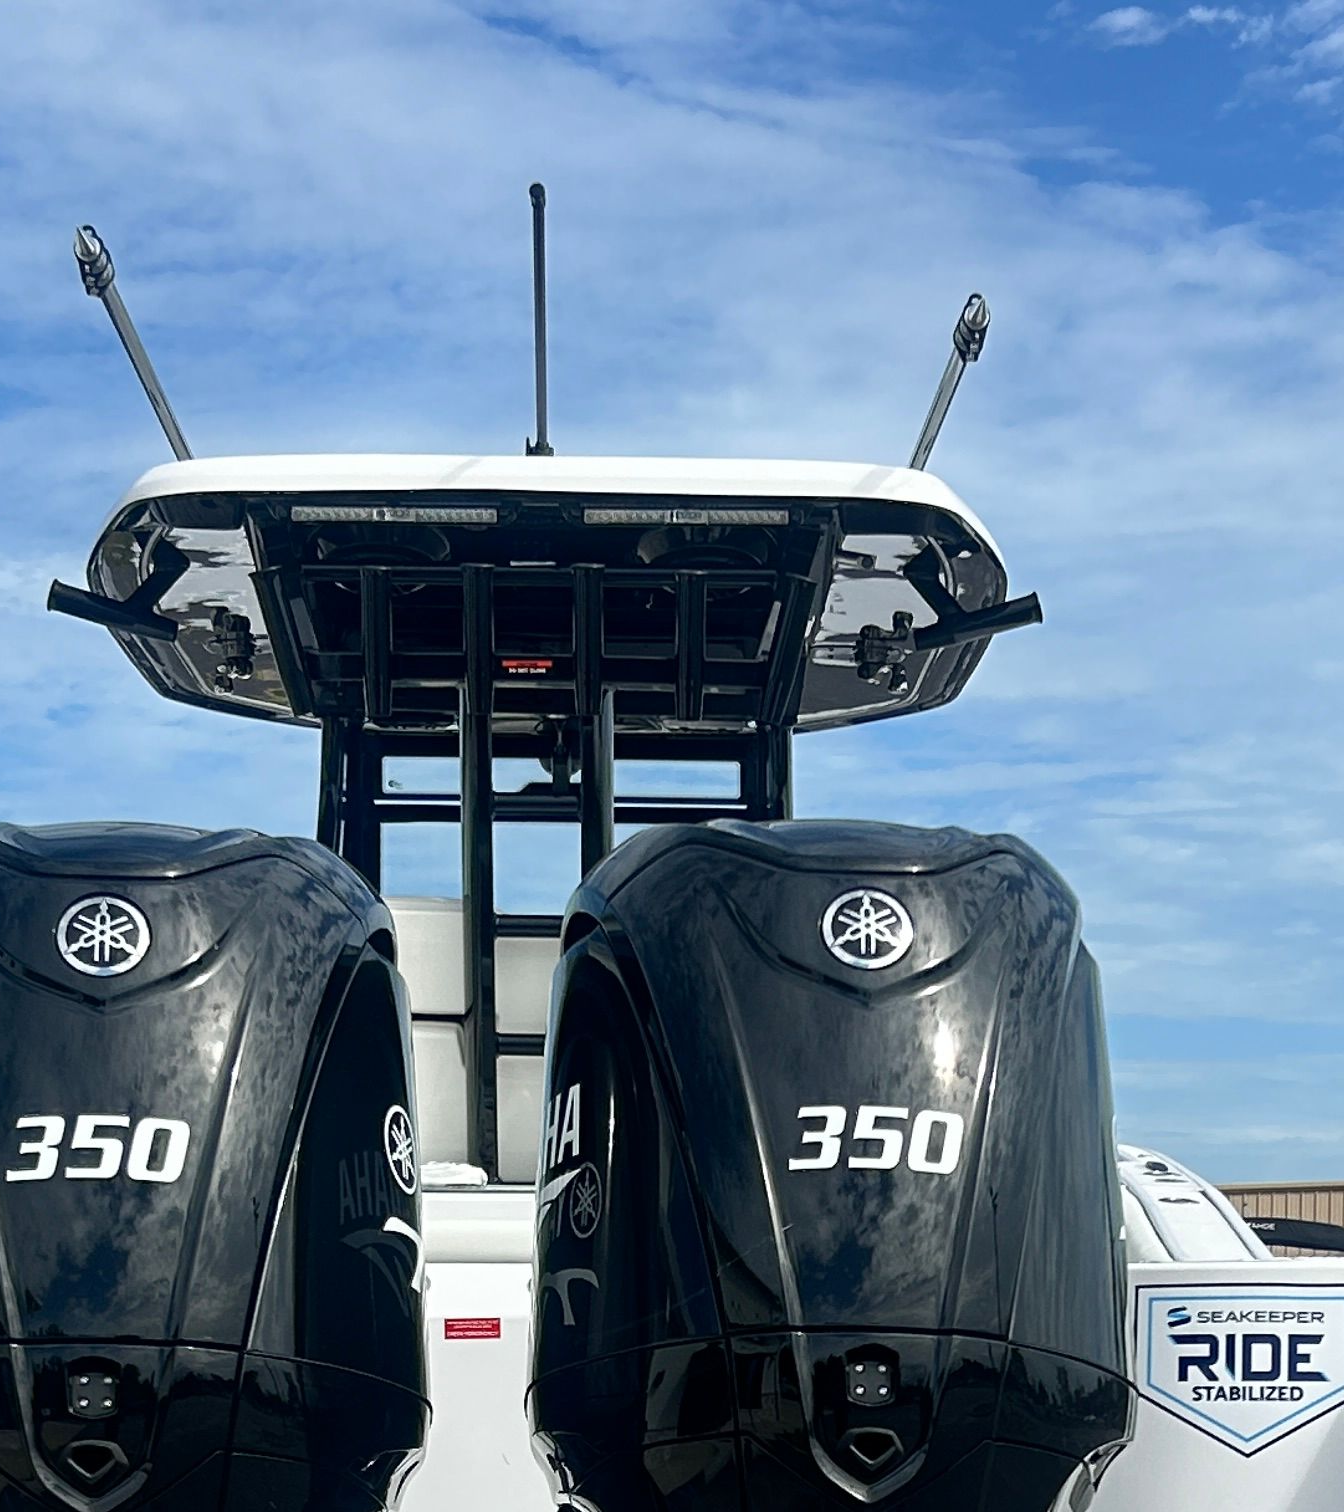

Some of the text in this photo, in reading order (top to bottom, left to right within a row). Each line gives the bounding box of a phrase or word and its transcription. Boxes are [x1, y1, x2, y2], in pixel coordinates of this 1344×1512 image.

[5, 1114, 190, 1183] 350
[787, 1106, 964, 1174] 350
[1197, 1311, 1324, 1323] SEAKEEPER
[1168, 1333, 1330, 1382] RIDE
[1192, 1386, 1304, 1401] STABILIZED
